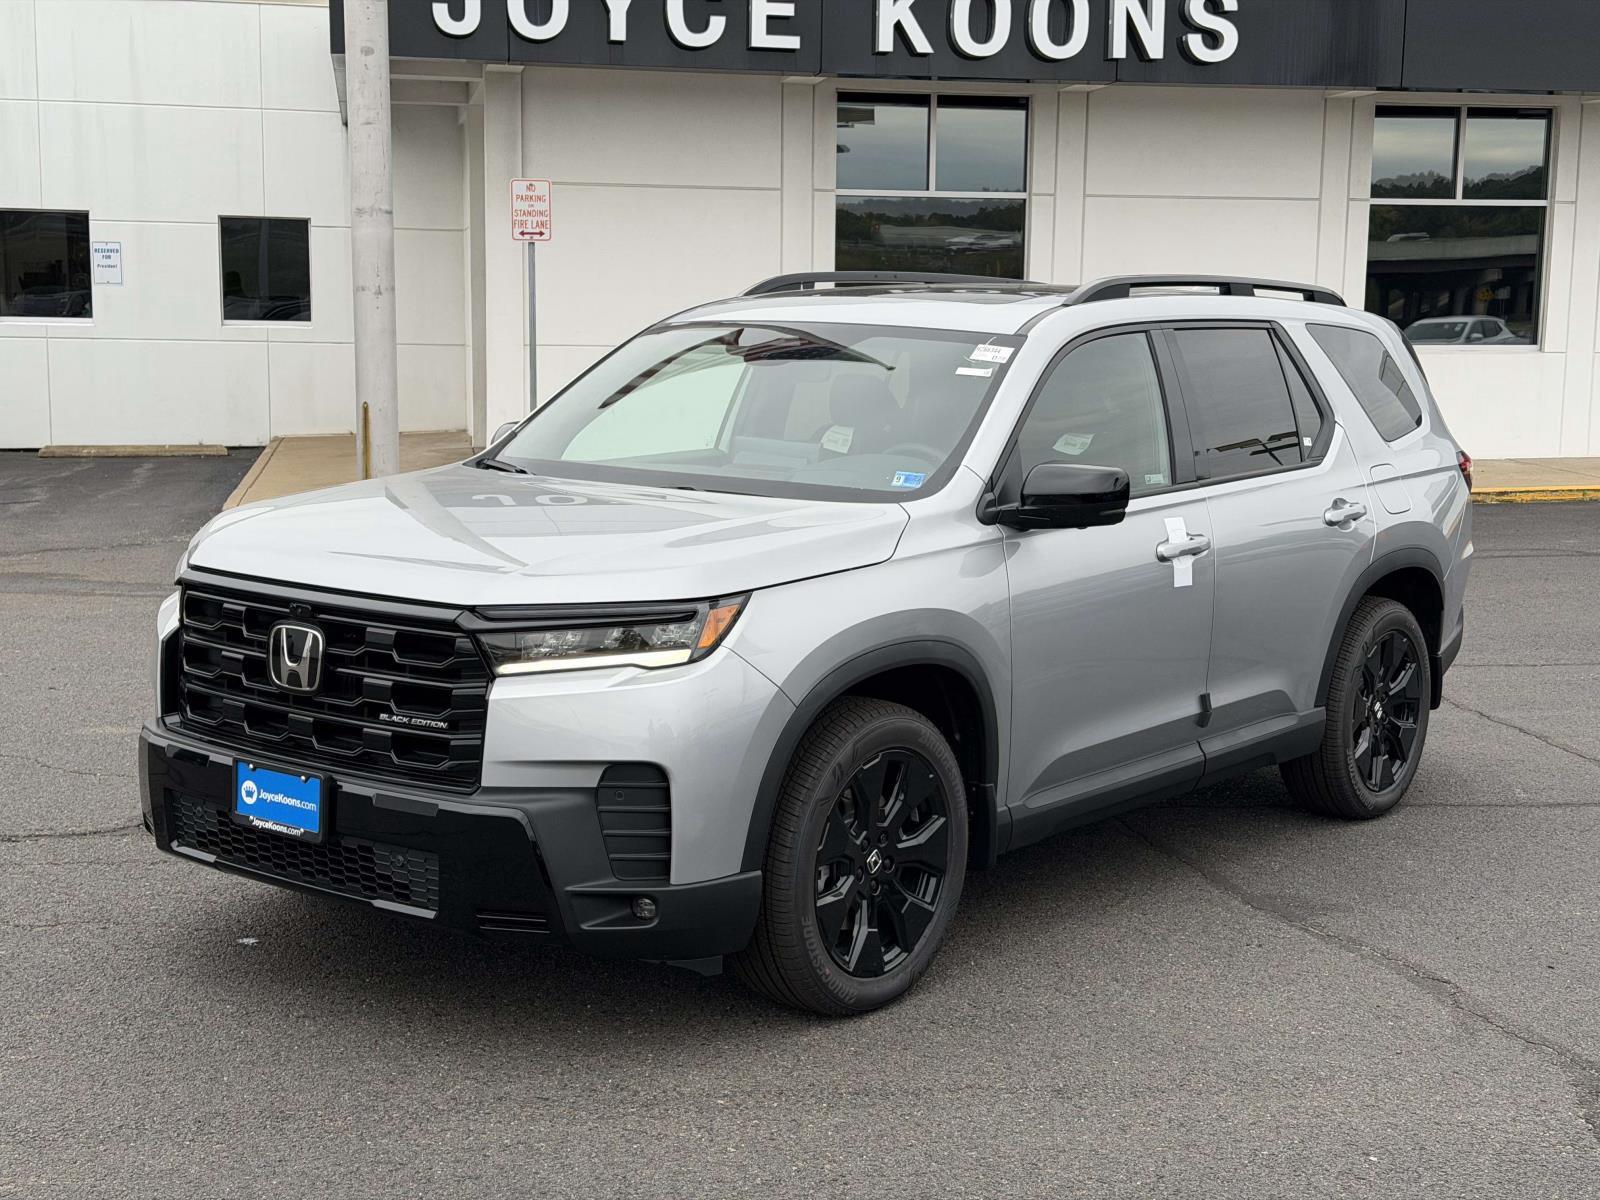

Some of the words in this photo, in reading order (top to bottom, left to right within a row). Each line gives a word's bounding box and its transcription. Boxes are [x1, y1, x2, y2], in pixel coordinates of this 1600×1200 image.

[874, 0, 1239, 63] KOONS
[525, 184, 536, 192] NO
[515, 194, 546, 203] PARKING
[513, 209, 549, 218] STANDING
[513, 219, 529, 229] FIRE
[530, 219, 549, 230] LANE
[379, 713, 411, 724] BLACK
[410, 718, 449, 729] EDITION
[258, 788, 317, 812] JoyceKoons.com
[252, 816, 301, 837] JoyceKoons.com
